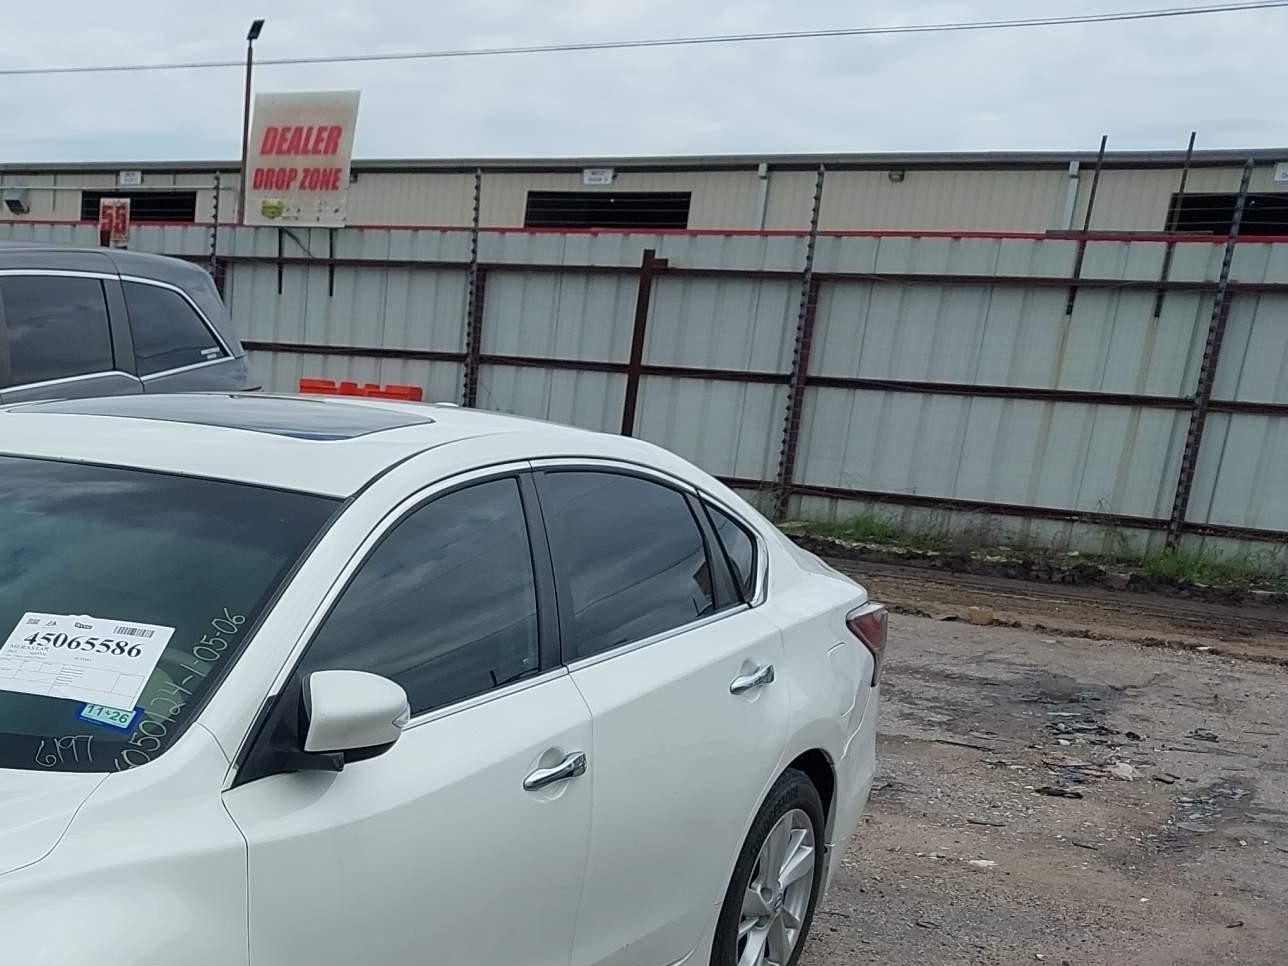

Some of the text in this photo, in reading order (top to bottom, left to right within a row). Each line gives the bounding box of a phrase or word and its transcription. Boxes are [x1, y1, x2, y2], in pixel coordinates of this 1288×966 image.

[260, 125, 343, 155] DEALER
[252, 167, 342, 191] DROP ZONE
[23, 631, 145, 659] 45065586
